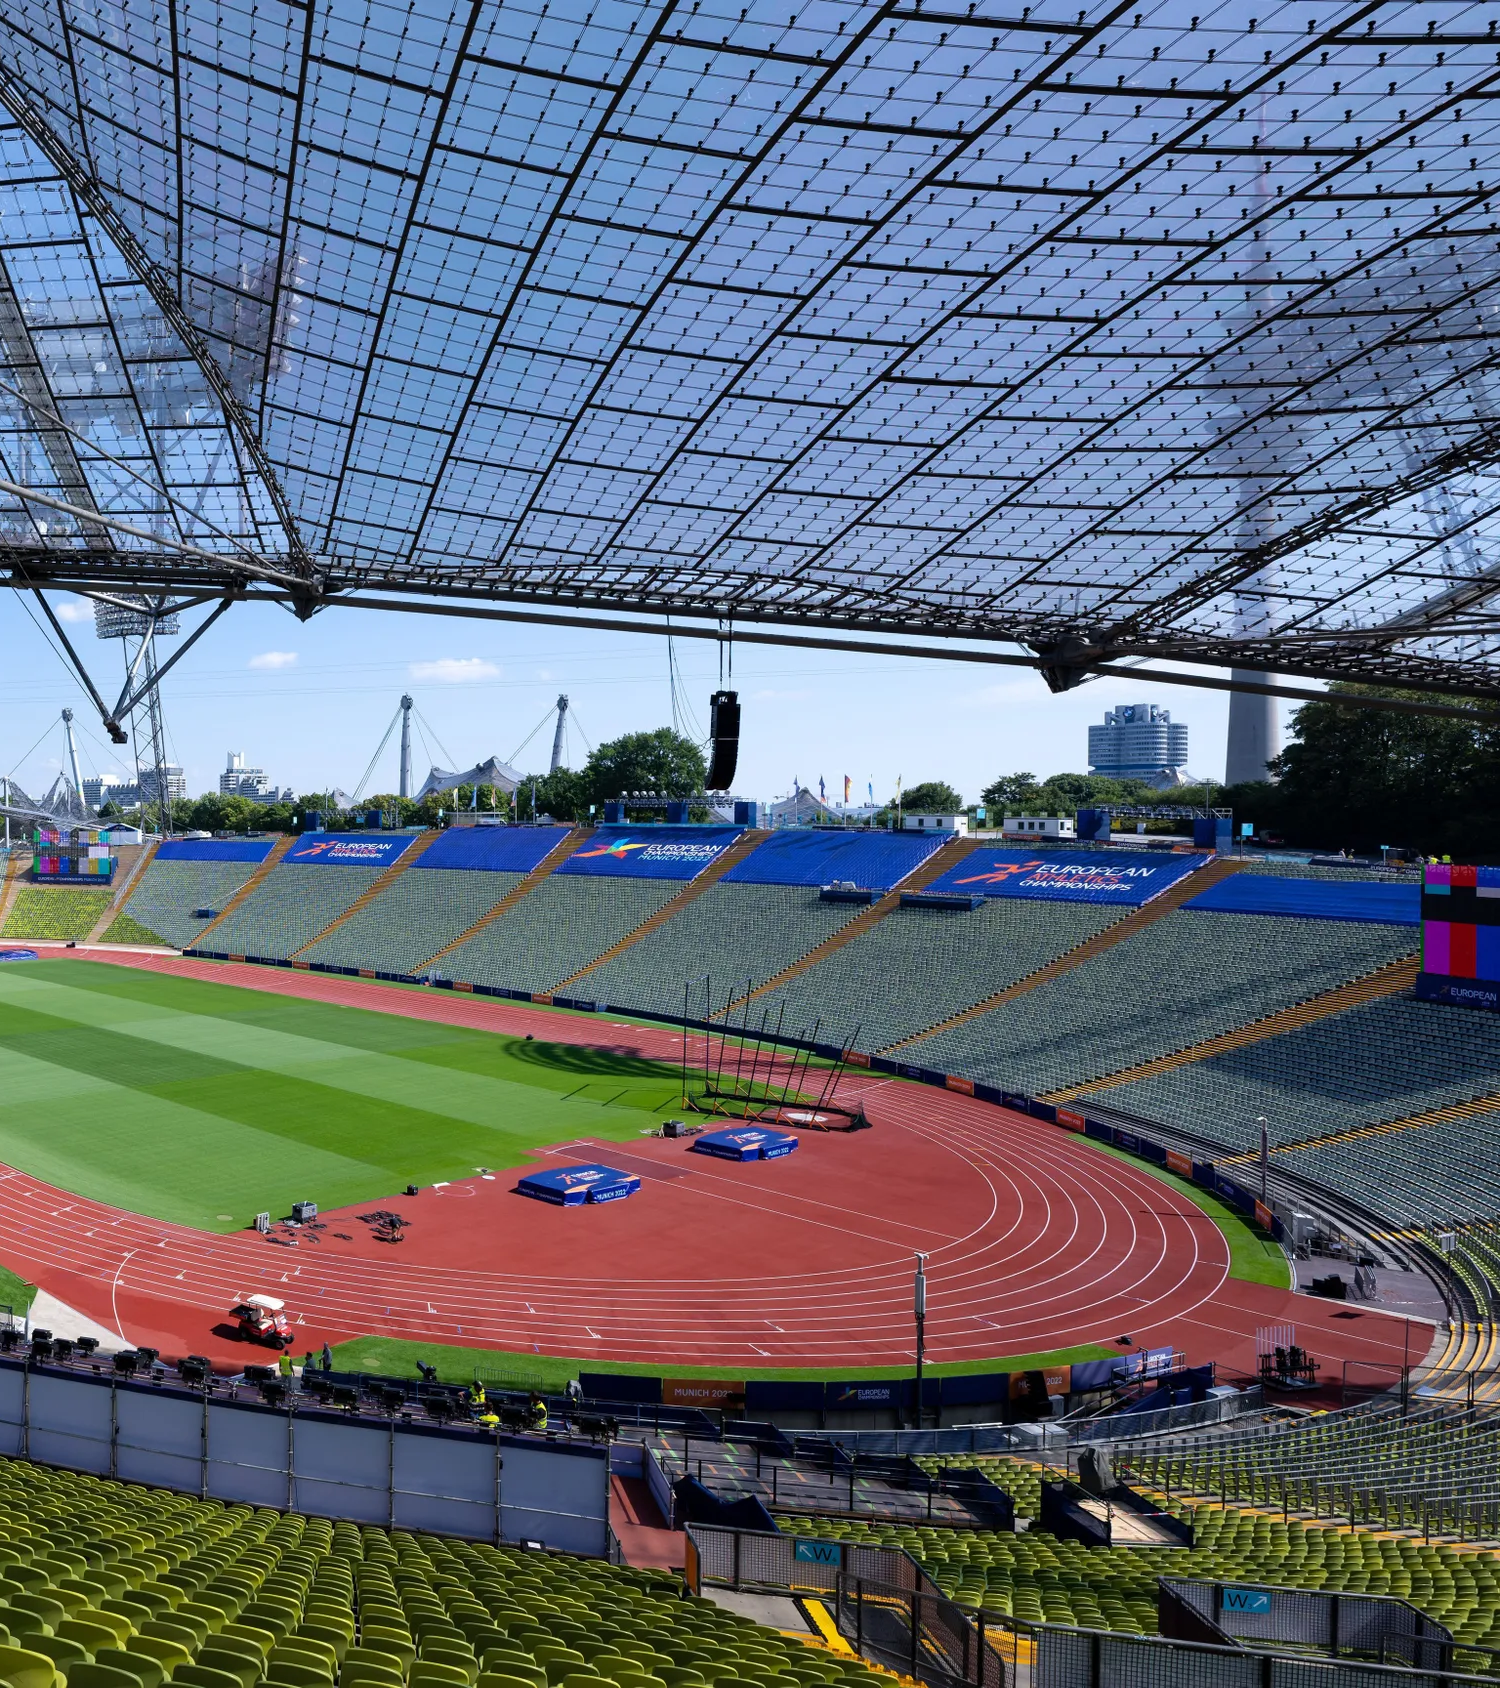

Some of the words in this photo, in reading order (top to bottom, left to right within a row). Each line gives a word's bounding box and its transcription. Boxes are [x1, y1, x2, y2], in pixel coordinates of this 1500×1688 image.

[334, 842, 393, 851] EUROPEAN
[646, 844, 723, 852] EUROPEAN
[1035, 864, 1157, 877] EUROPEAN
[1026, 873, 1123, 884] ATHLETICS
[1019, 880, 1135, 891] CHAMPIONSHIPS
[1450, 987, 1497, 1001] EUROPEAN
[1046, 1377, 1063, 1385] 2022
[674, 1388, 709, 1397] MUNICH
